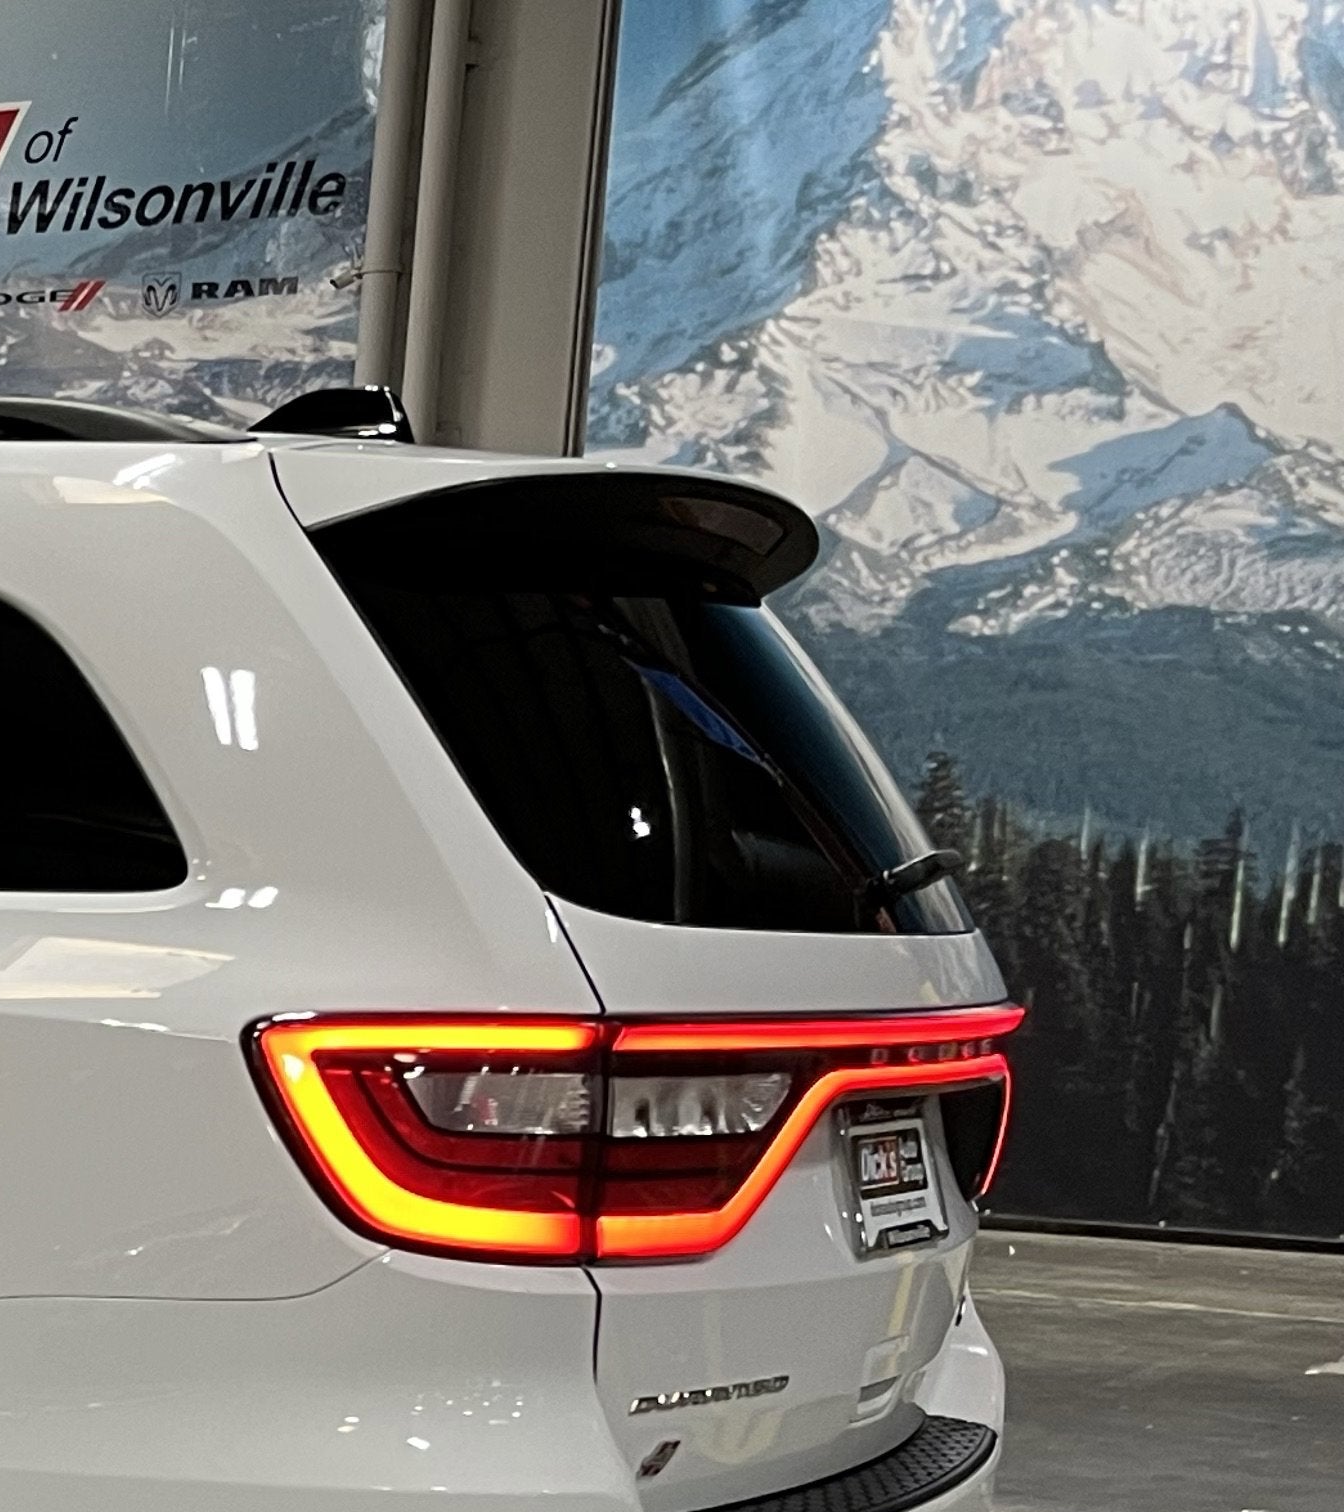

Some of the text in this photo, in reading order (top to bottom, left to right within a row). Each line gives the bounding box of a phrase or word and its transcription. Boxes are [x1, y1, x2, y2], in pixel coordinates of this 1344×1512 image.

[24, 117, 78, 164] of
[6, 159, 347, 235] Wilsonville
[192, 277, 298, 299] RAM
